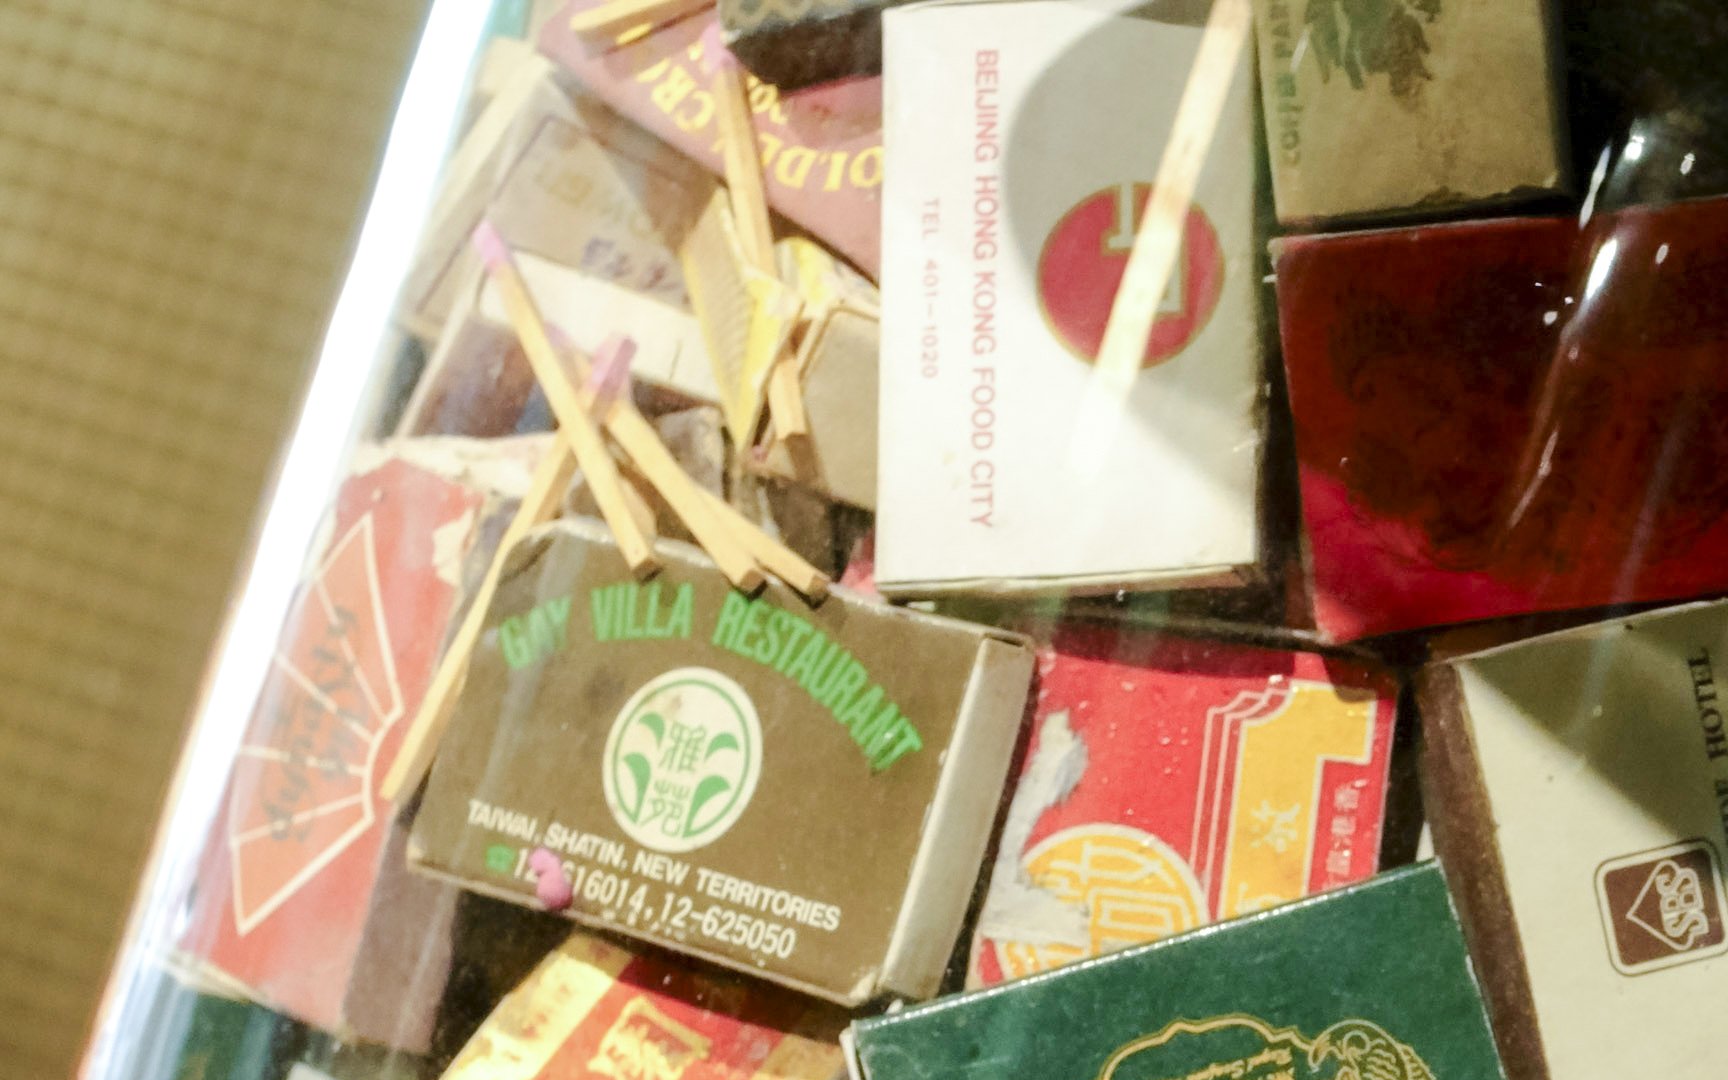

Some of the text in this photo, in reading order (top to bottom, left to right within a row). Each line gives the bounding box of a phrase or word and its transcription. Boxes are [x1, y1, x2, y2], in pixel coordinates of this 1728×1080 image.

[922, 199, 939, 242] TEL
[970, 49, 999, 529] BEIJING HONG KONG FOOD CITY
[498, 582, 923, 773] GAY VILLA RESTAURANT
[1689, 649, 1728, 760] HOTEL
[633, 852, 687, 884] NEW
[695, 869, 841, 931] TERRITORIES
